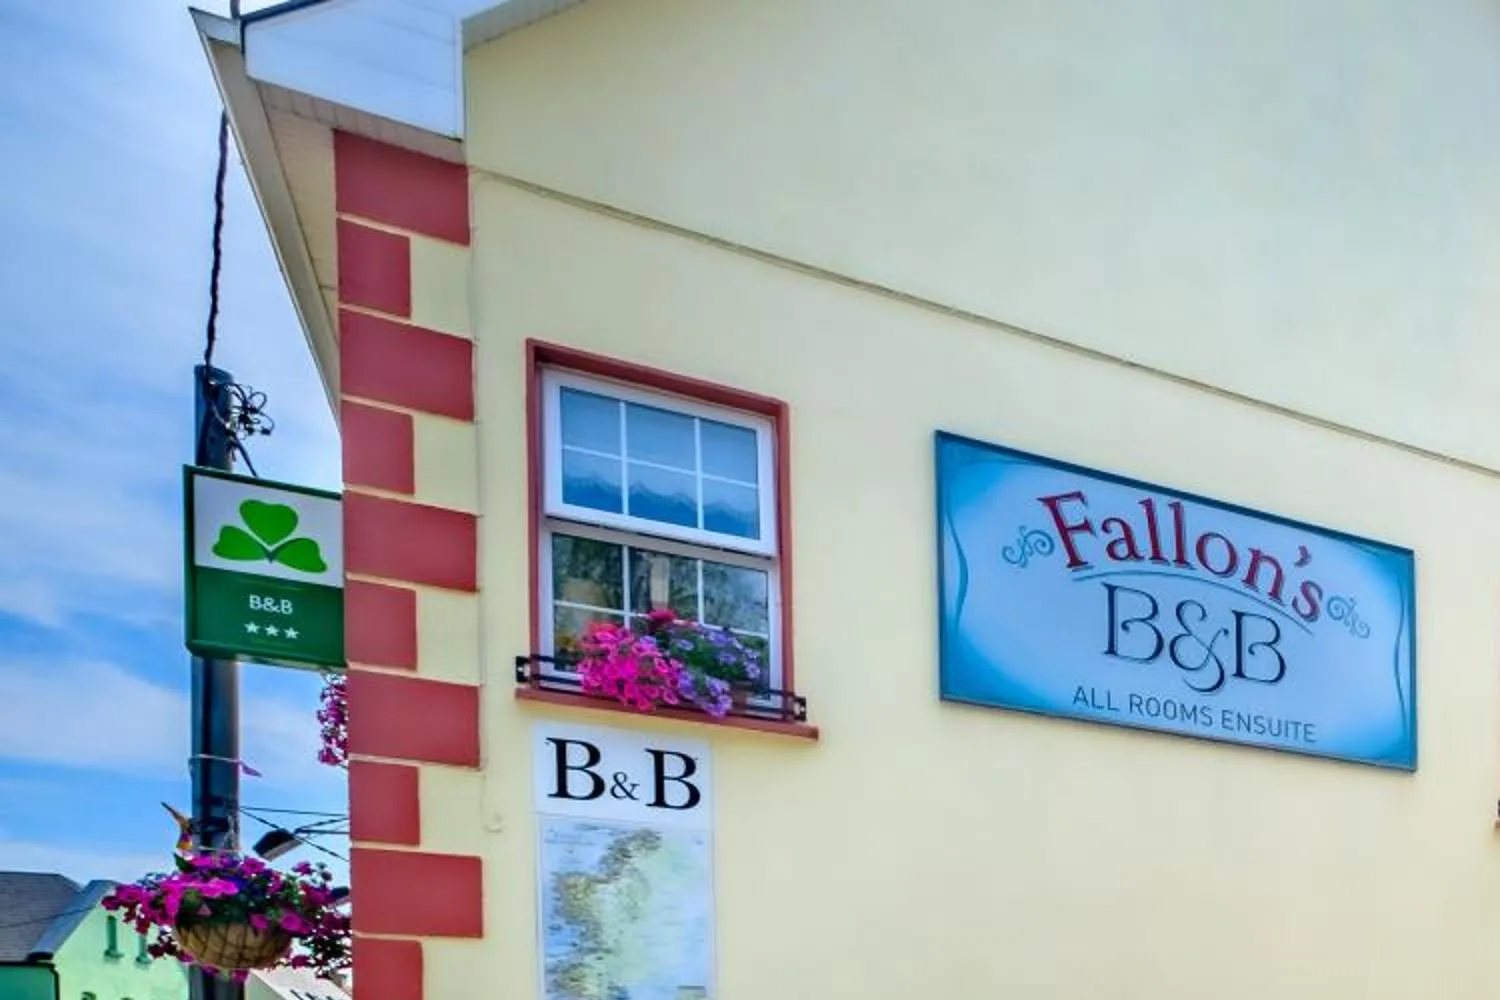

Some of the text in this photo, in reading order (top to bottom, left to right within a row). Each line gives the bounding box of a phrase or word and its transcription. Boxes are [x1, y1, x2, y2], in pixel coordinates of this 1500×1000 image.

[1037, 490, 1325, 624] Fallon's
[249, 594, 293, 615] B&B
[1102, 582, 1287, 694] B&B
[1072, 685, 1317, 743] ALL ROOMS ENSUITE
